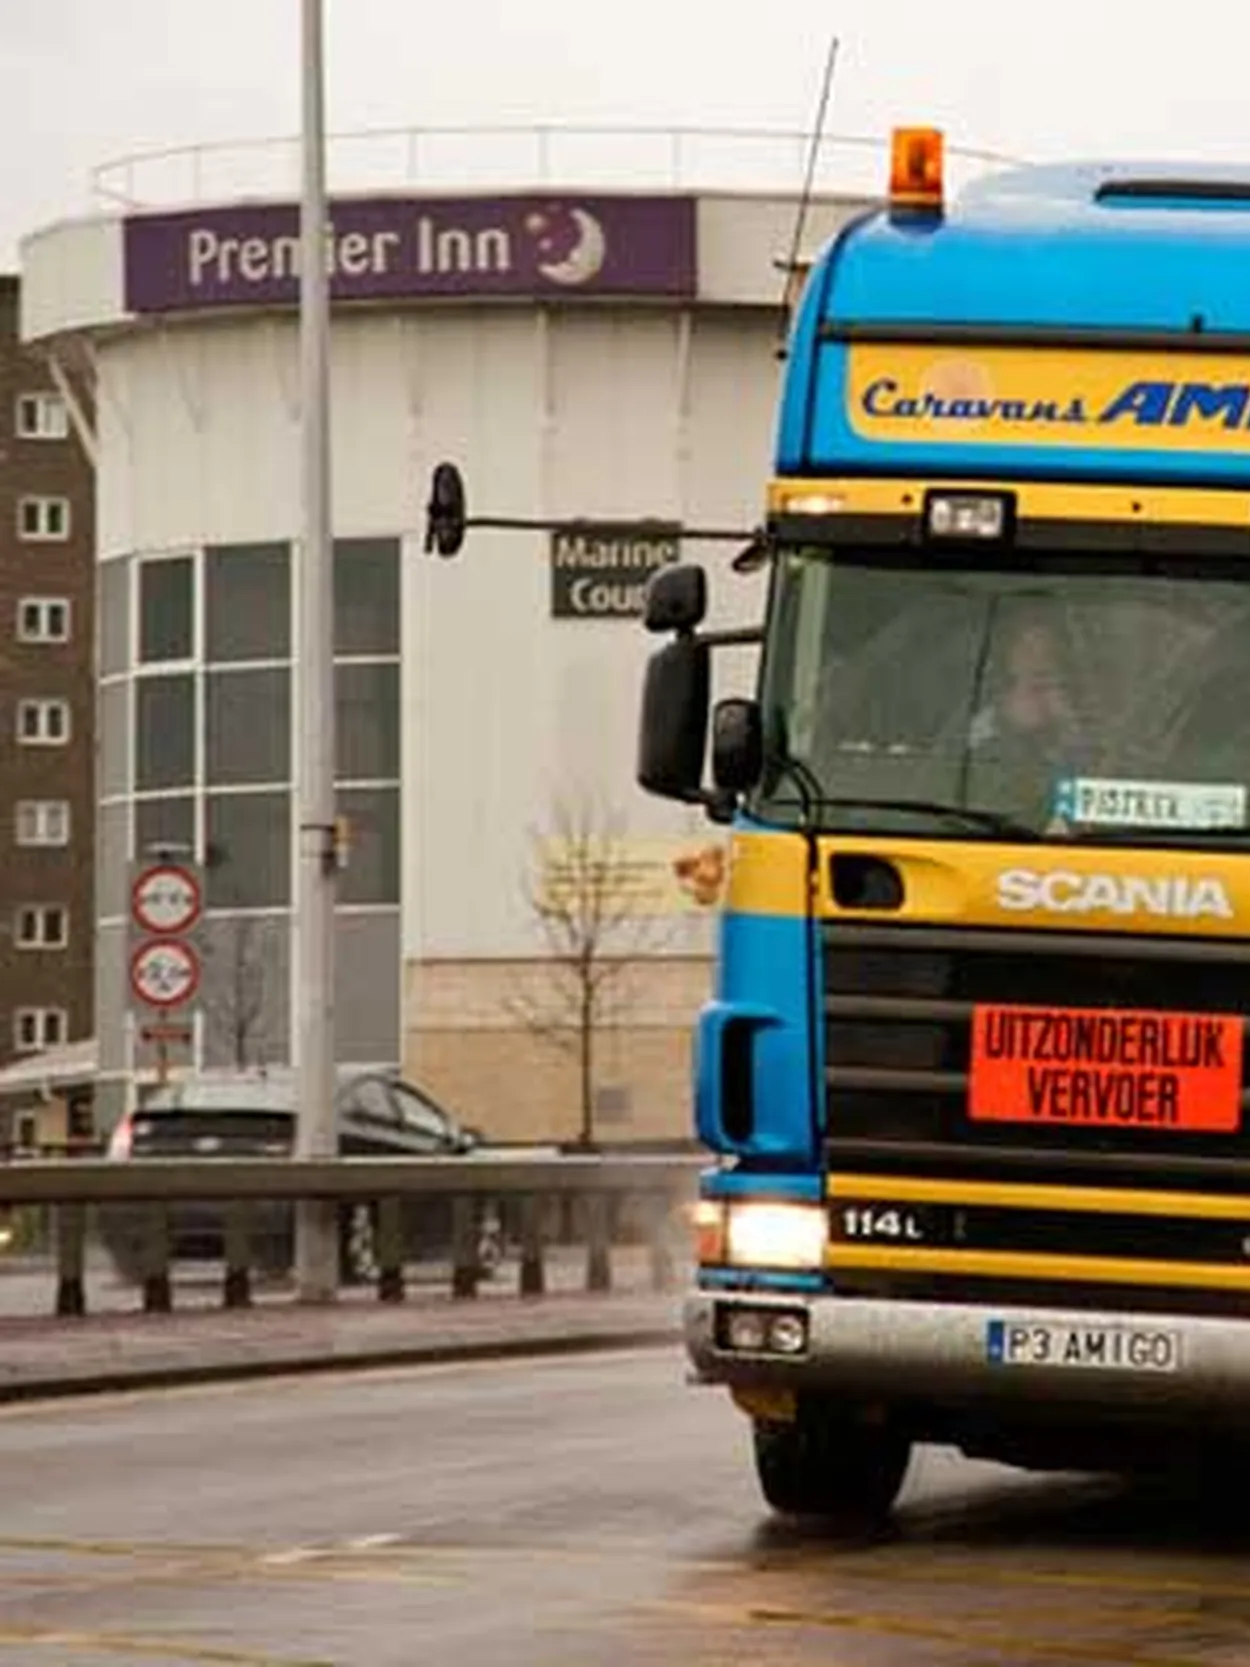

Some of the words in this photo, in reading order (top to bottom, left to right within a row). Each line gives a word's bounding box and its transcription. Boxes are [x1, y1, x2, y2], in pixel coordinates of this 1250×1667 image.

[418, 217, 510, 272] Inn
[861, 377, 1087, 424] Caravans
[996, 868, 1234, 918] SCANIA
[1028, 1067, 1179, 1121] VERVOER
[1009, 1328, 1050, 1361] P3
[1064, 1332, 1171, 1367] AMIGO
